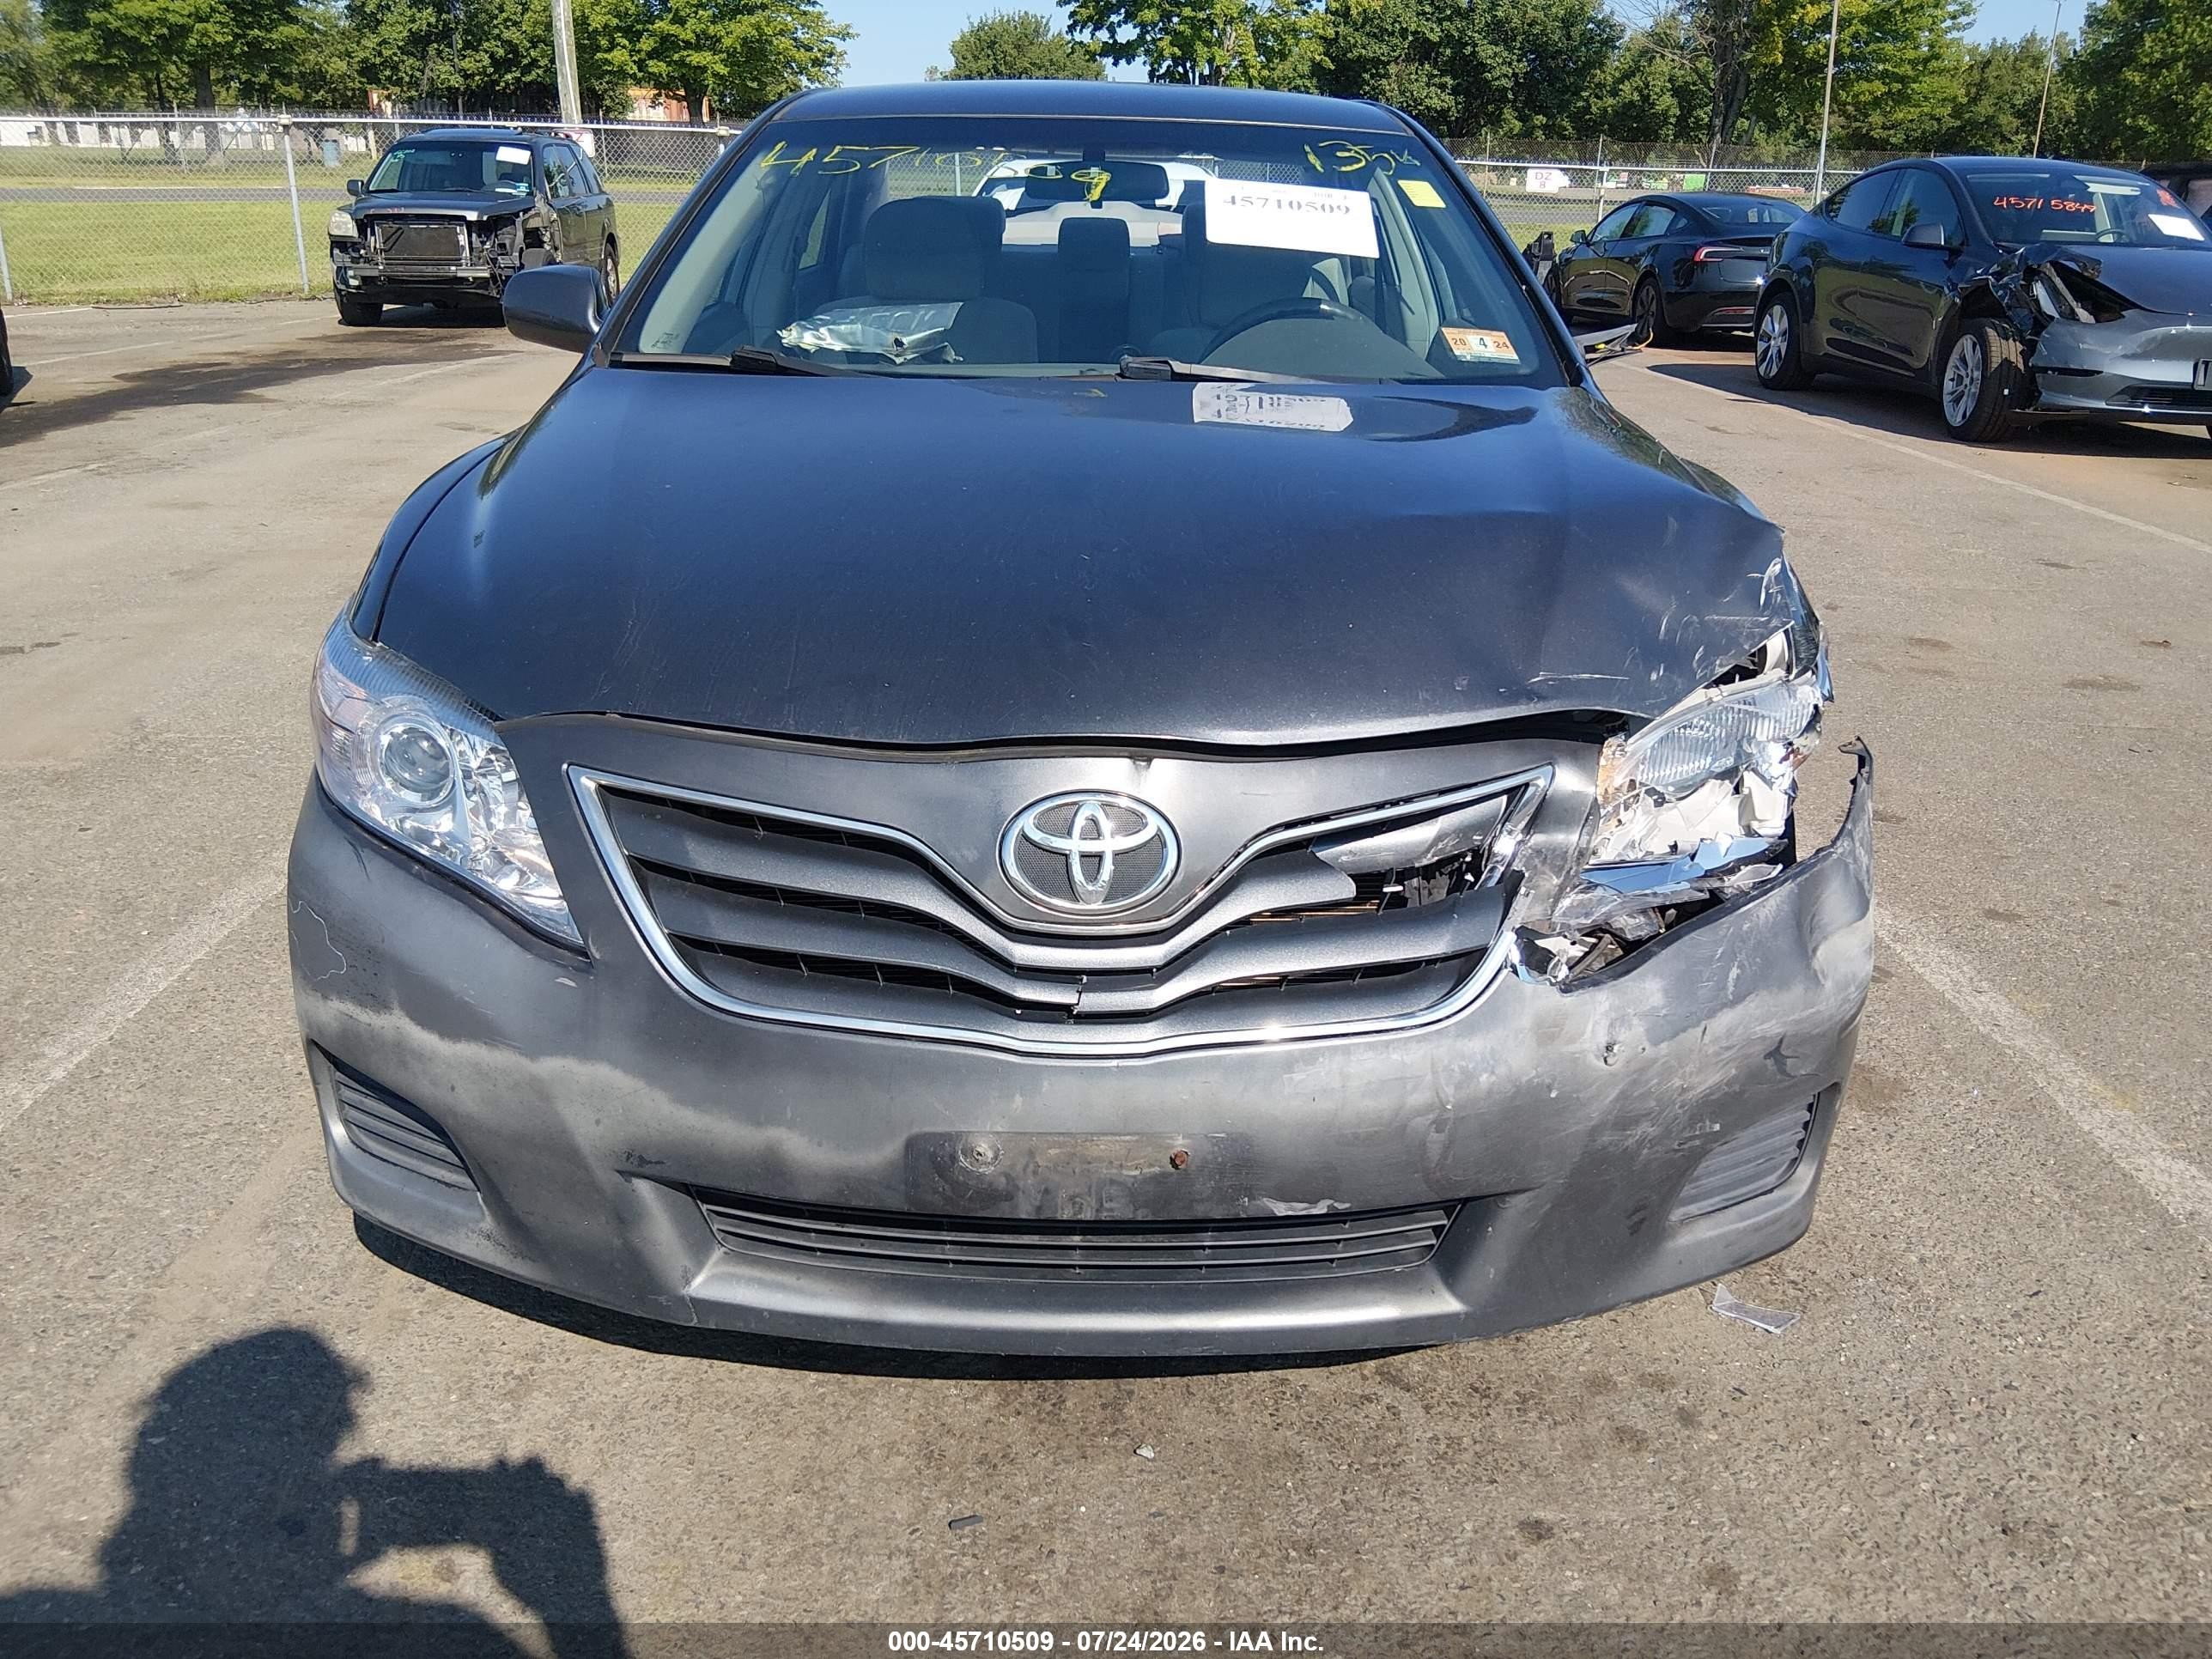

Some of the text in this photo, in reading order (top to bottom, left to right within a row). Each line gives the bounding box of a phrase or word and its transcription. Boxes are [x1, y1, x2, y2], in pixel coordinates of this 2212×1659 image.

[1534, 172, 1553, 180] DZ
[1223, 194, 1351, 215] 45710509
[1451, 337, 1510, 349] 20 4 24
